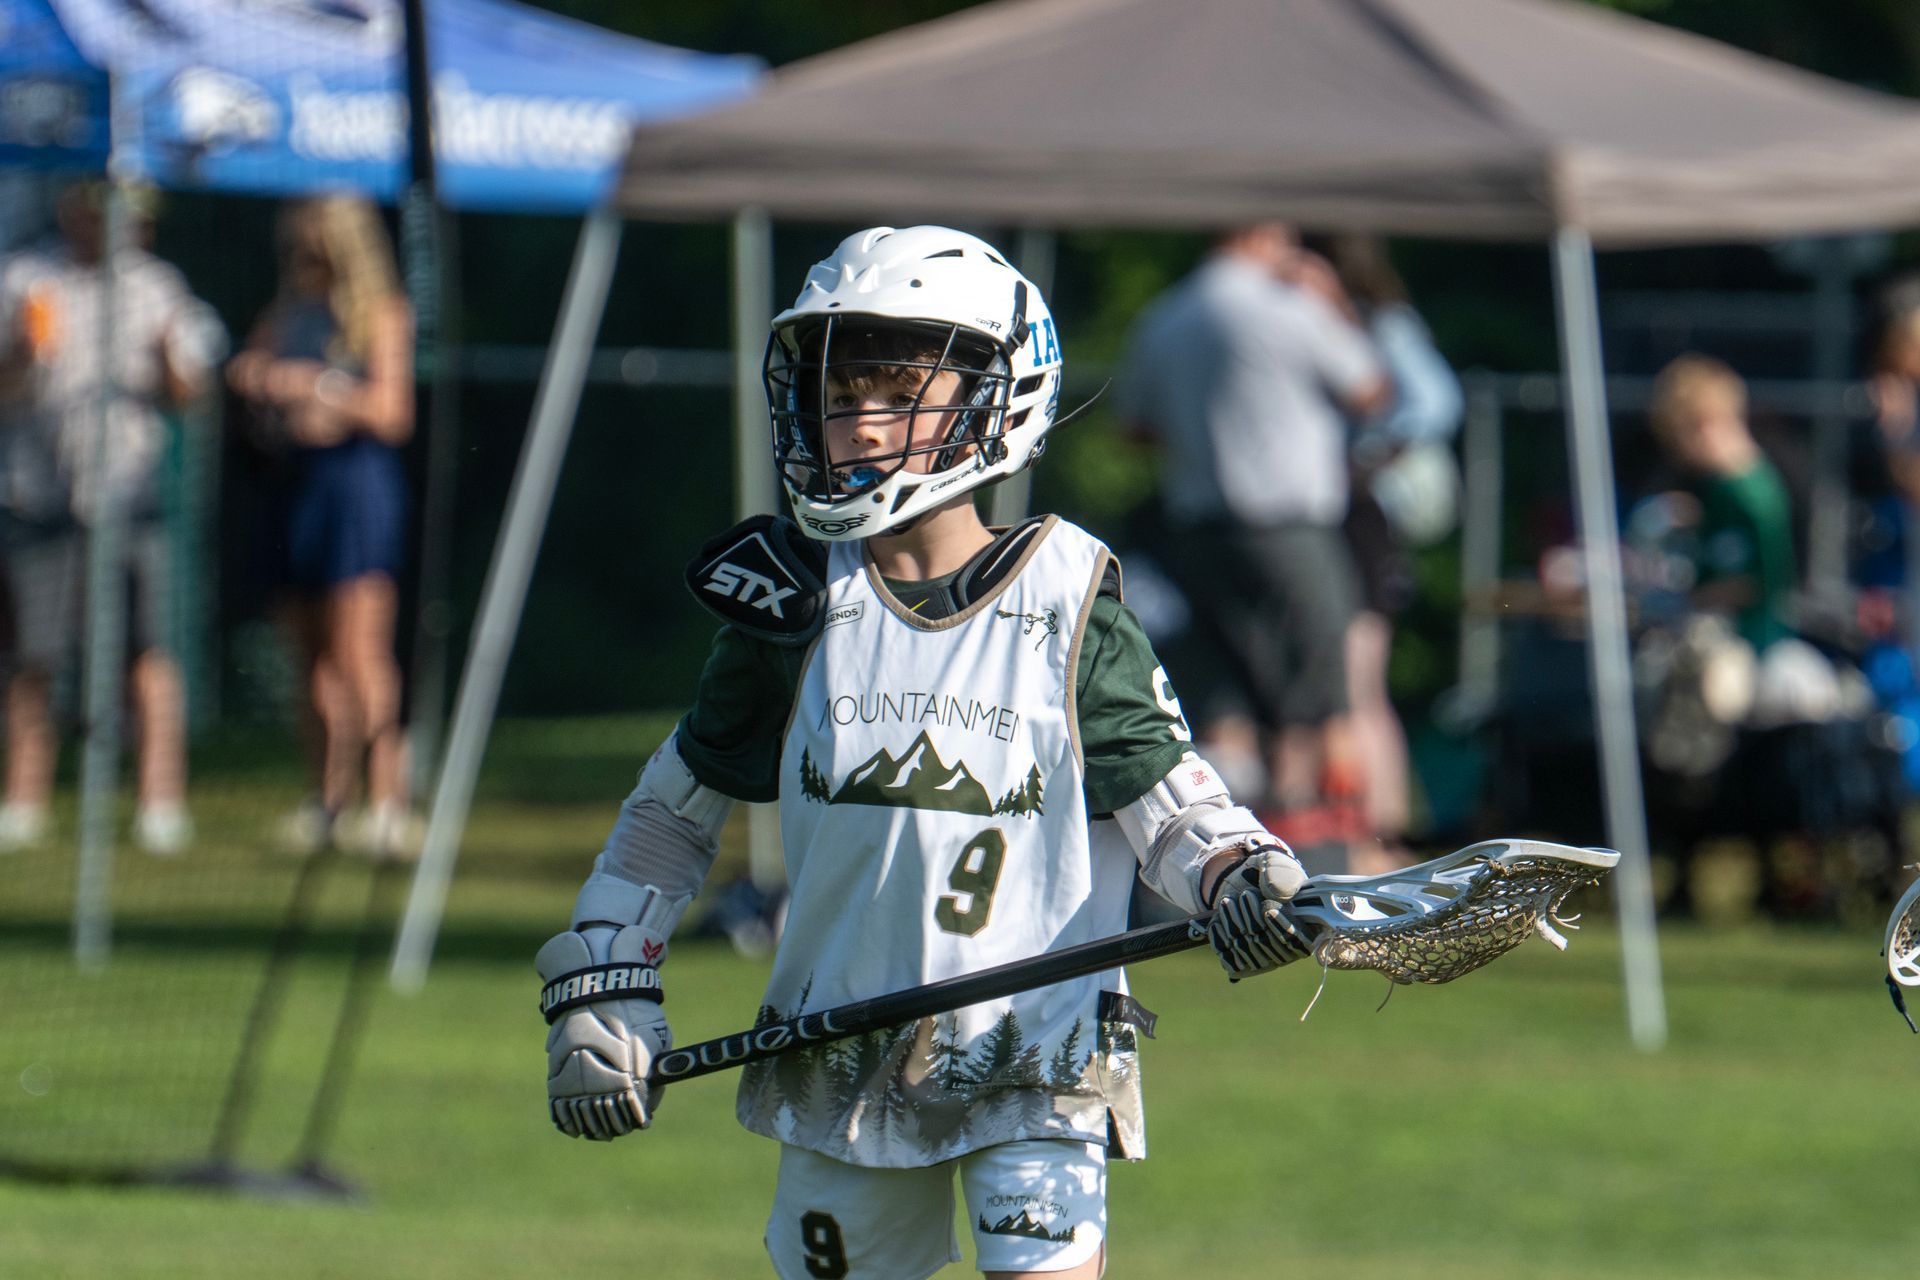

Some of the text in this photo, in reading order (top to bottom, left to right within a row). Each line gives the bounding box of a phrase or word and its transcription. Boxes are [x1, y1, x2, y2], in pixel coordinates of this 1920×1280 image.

[703, 562, 797, 619] STX
[934, 827, 1008, 939] 9
[658, 1011, 847, 1076] owell
[985, 1194, 1069, 1218] MOUNTAINMEN
[799, 1209, 849, 1280] 9
